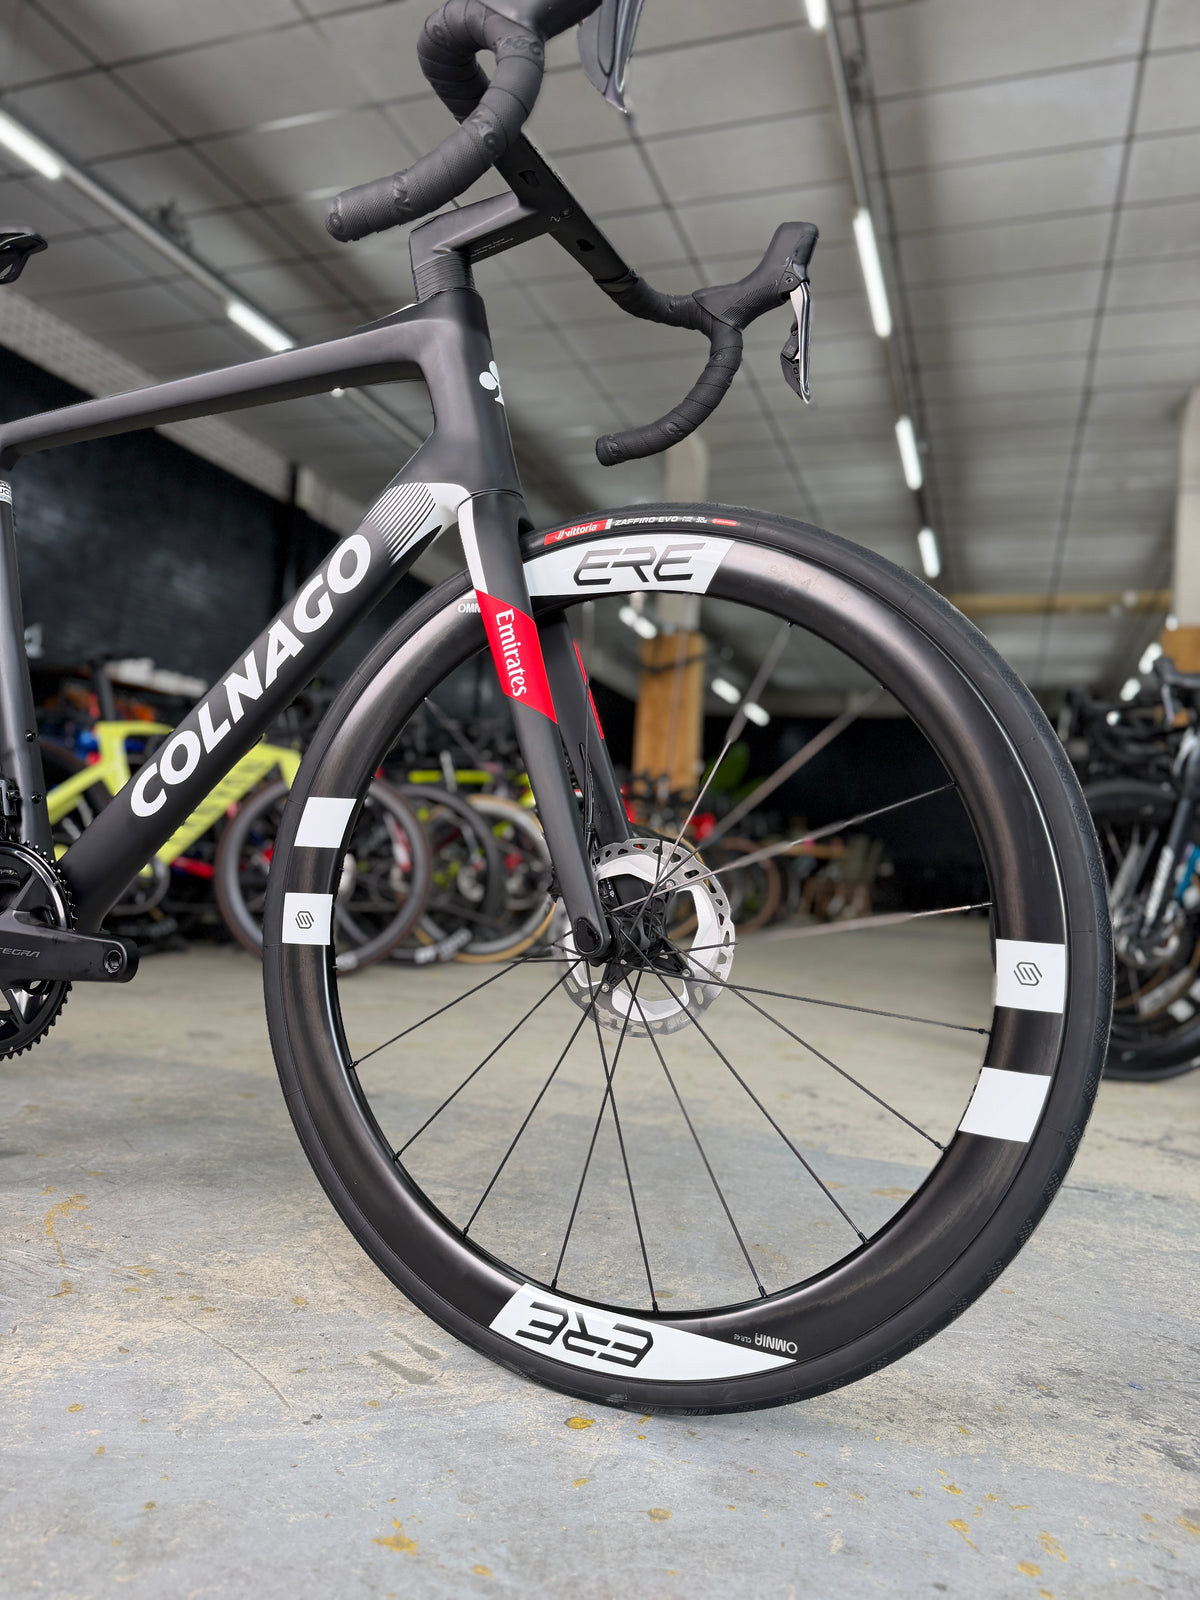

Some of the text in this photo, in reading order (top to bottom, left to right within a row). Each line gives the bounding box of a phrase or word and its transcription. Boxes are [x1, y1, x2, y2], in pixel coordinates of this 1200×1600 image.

[564, 523, 598, 538] vittoria
[614, 516, 656, 526] ZAFFIRO
[573, 542, 706, 586] ERE
[457, 602, 482, 614] OMN
[496, 608, 527, 697] Emirates
[130, 534, 371, 817] COLNAGO
[0, 947, 41, 958] EGRA
[515, 1302, 654, 1368] ERE
[754, 1332, 798, 1354] OMNIA
